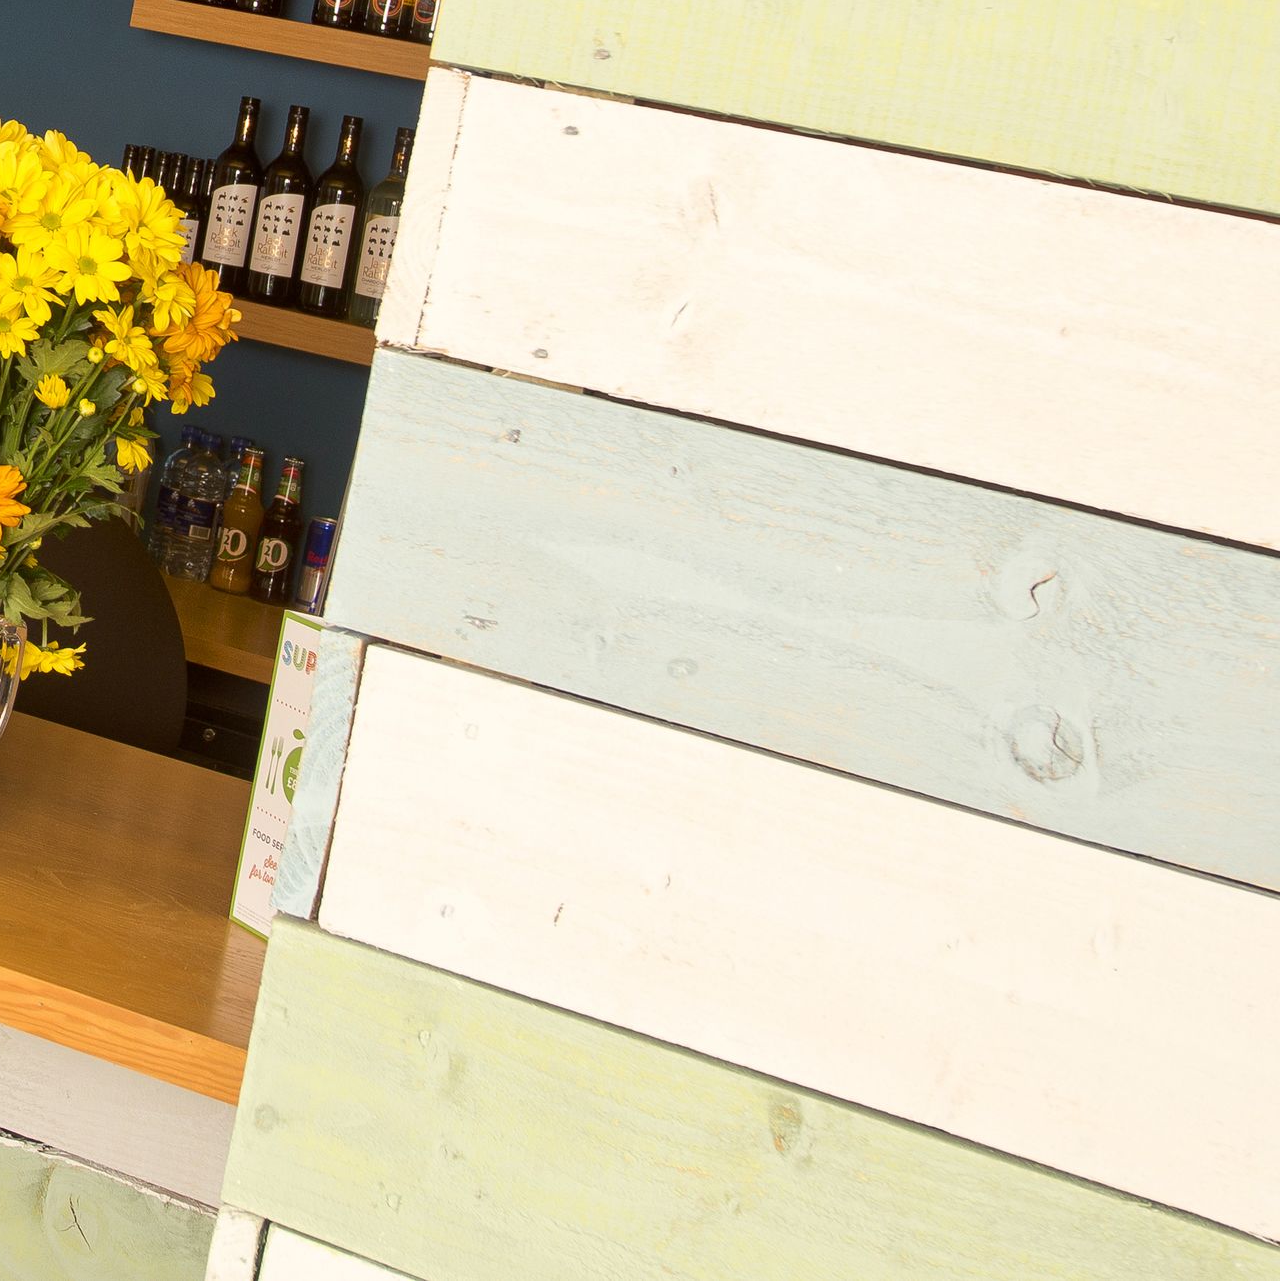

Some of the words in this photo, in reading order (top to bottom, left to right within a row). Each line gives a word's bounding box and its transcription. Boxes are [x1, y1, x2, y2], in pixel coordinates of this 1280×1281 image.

[252, 828, 271, 845] FOOD
[263, 855, 278, 871] See
[248, 864, 263, 880] for
[262, 870, 274, 886] ton
